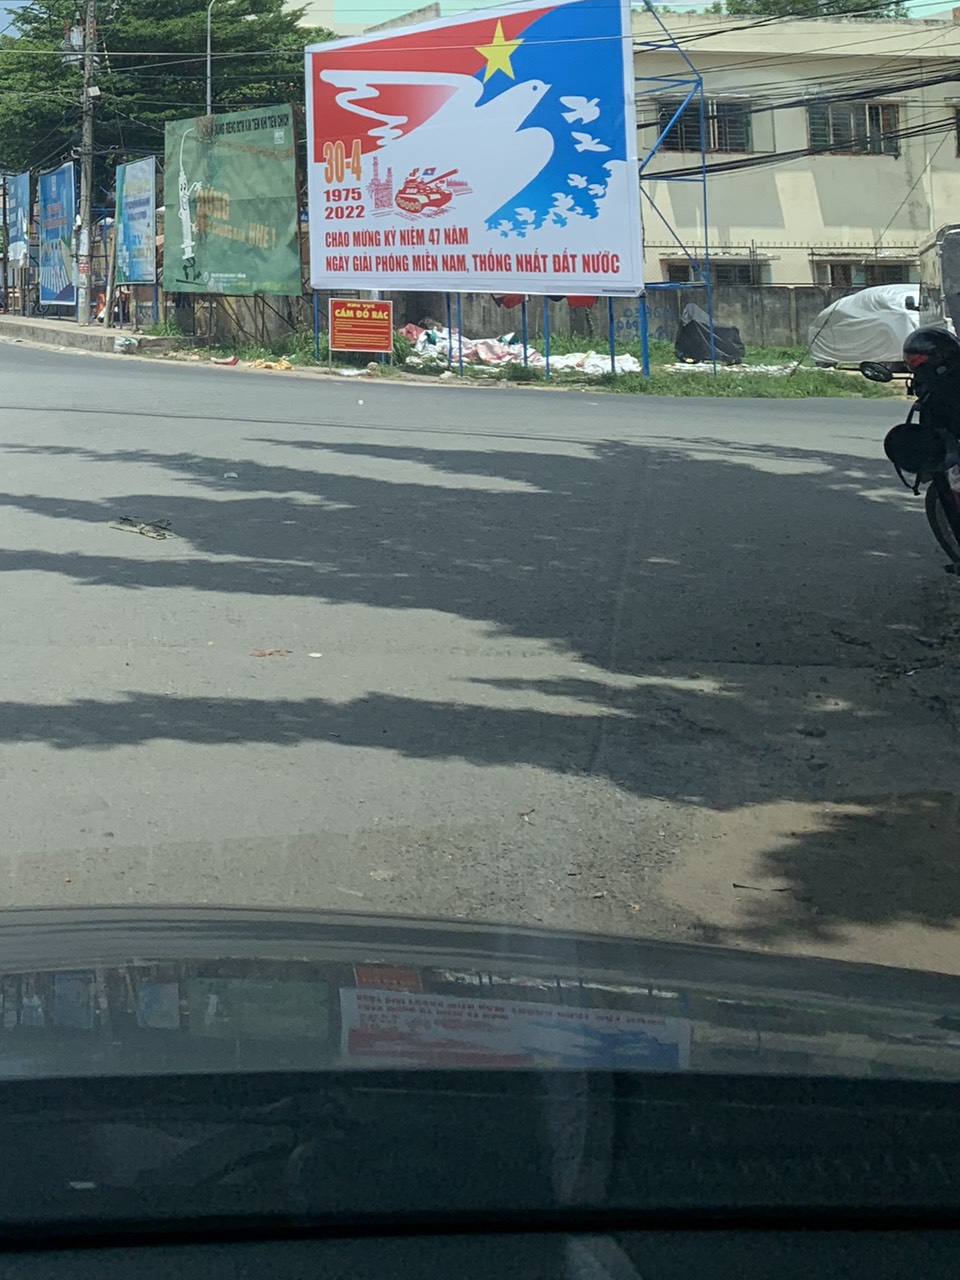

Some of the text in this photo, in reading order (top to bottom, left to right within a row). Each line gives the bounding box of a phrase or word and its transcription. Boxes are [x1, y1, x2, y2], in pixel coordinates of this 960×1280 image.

[323, 139, 362, 184] 30-4
[323, 187, 362, 202] 1975
[324, 205, 366, 220] 2022
[325, 228, 350, 248] CHÀO
[352, 227, 381, 247] MỪNG
[399, 225, 425, 249] NIỆM
[428, 228, 440, 246] 47
[443, 225, 469, 246] NĂM
[325, 248, 620, 274] NGÀY GIẢI PHÓNG MIỀN NAM, THỐNG NHẤT ĐẤT NƯỚC
[335, 306, 354, 318] CẤM
